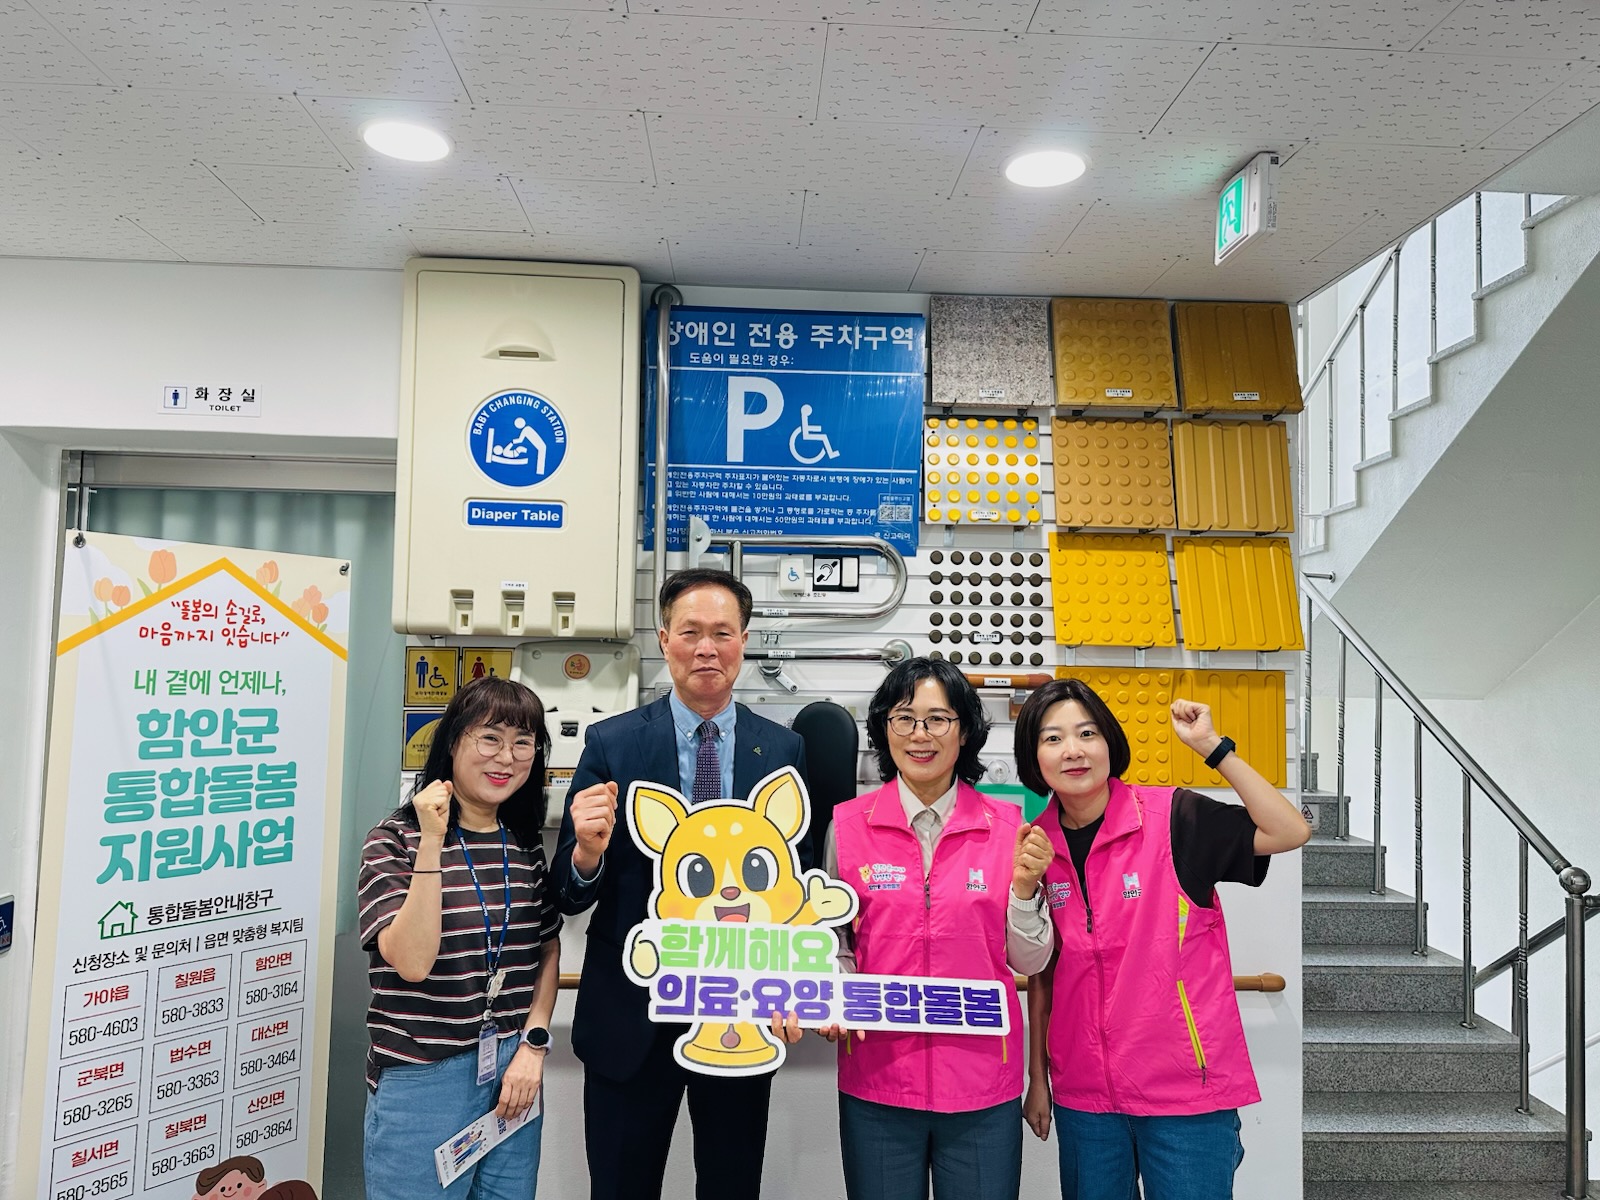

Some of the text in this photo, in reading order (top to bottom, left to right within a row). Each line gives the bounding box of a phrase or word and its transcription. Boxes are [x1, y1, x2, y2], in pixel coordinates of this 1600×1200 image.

[748, 322, 798, 350] 전용
[810, 324, 914, 351] 주차구역
[690, 352, 794, 366] 도움이 필요한 경우:
[208, 404, 242, 412] TOILET
[472, 395, 564, 444] BABY CHANGING STATION
[726, 375, 785, 463] P
[745, 482, 752, 490] 수
[875, 476, 889, 484] 있는
[778, 506, 784, 514] 그
[814, 494, 852, 502] 부과합니다.
[471, 508, 560, 522] Diaper Table
[225, 599, 266, 624] 손길로,
[138, 622, 214, 646] 마음까지
[134, 669, 288, 696] 내 곁에 언제나,
[136, 708, 280, 760] 함안군
[104, 761, 298, 824] 통합돌봄
[96, 816, 295, 885] 지원사업
[146, 888, 274, 926] 통합돌봄안내창구
[72, 917, 305, 974] 신청장소 및 문의처 읍면 맞춤형 복지팀
[658, 922, 834, 974] 함께해요
[254, 952, 293, 972] 함안면
[174, 967, 216, 990] 칠원읍
[82, 984, 130, 1008] 가야읍
[245, 980, 298, 1006] 580-3164
[654, 974, 1004, 1028] 의료·요양 통합돌봄
[160, 998, 224, 1025] 580-3833
[68, 1016, 139, 1046] 580-4603
[250, 1020, 289, 1042] 대산면
[168, 1040, 212, 1064] 법수면
[240, 1048, 296, 1077] 580-3464
[76, 1062, 125, 1088] 군북면
[156, 1070, 220, 1100] 580-3363
[62, 1092, 134, 1127] 580-3265
[246, 1090, 286, 1114] 산인면
[164, 1114, 208, 1140] 칠북면
[236, 1118, 292, 1150] 580-3864
[70, 1140, 120, 1168] 칠서면
[152, 1144, 216, 1178] 580-3663
[56, 1170, 128, 1200] 580-3565
